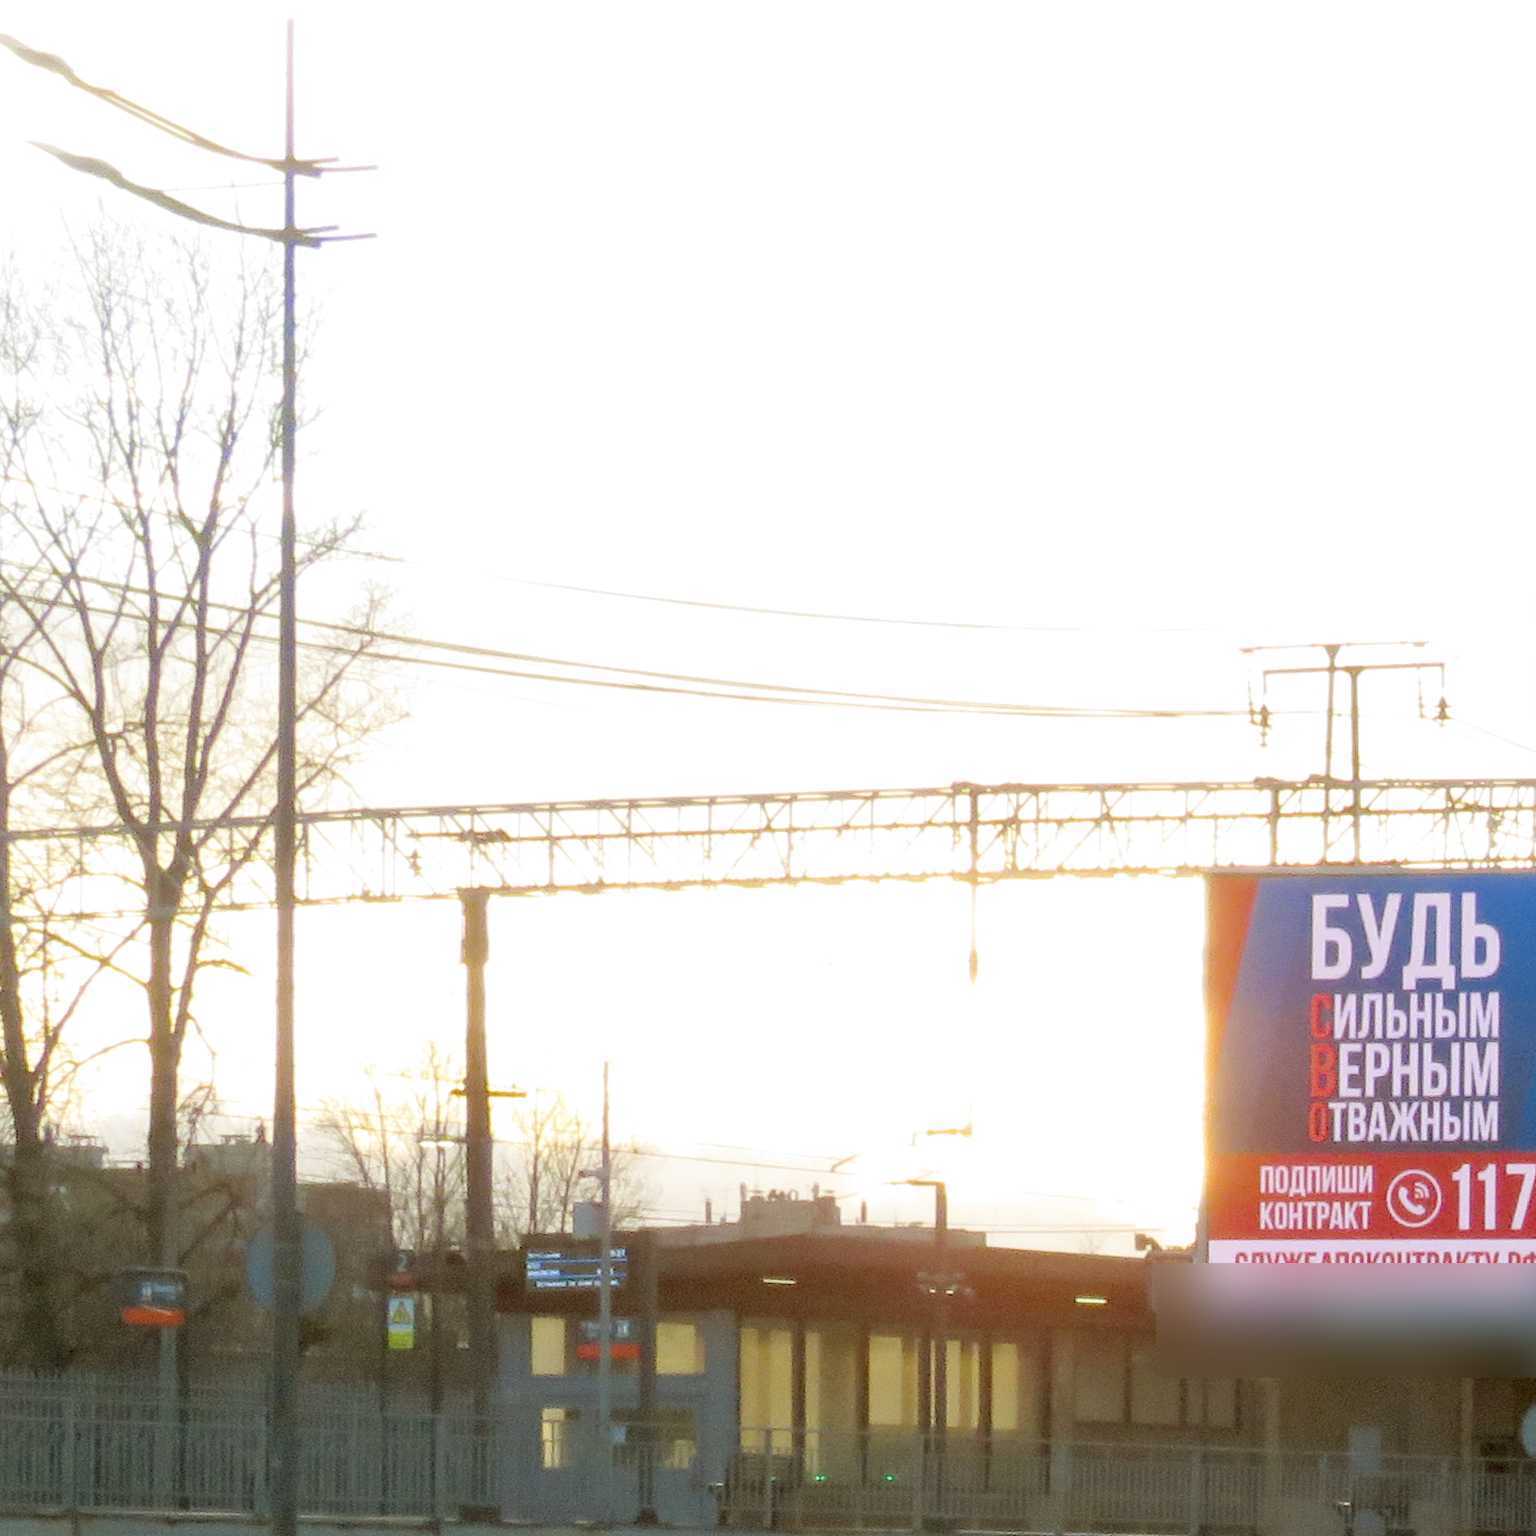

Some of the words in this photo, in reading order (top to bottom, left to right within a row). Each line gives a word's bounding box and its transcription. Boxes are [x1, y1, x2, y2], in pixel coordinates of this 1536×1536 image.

[1311, 892, 1500, 990] БУДЬ
[1310, 992, 1500, 1039] СИЛЬНЫМ
[1310, 1042, 1500, 1098] ВЕРНЫМ
[1308, 1101, 1499, 1142] ОТВАЖНЫМ
[1259, 1165, 1373, 1197] ПОДПИШИ
[1452, 1163, 1536, 1230] 117
[1259, 1201, 1372, 1230] КОНТРАКТ
